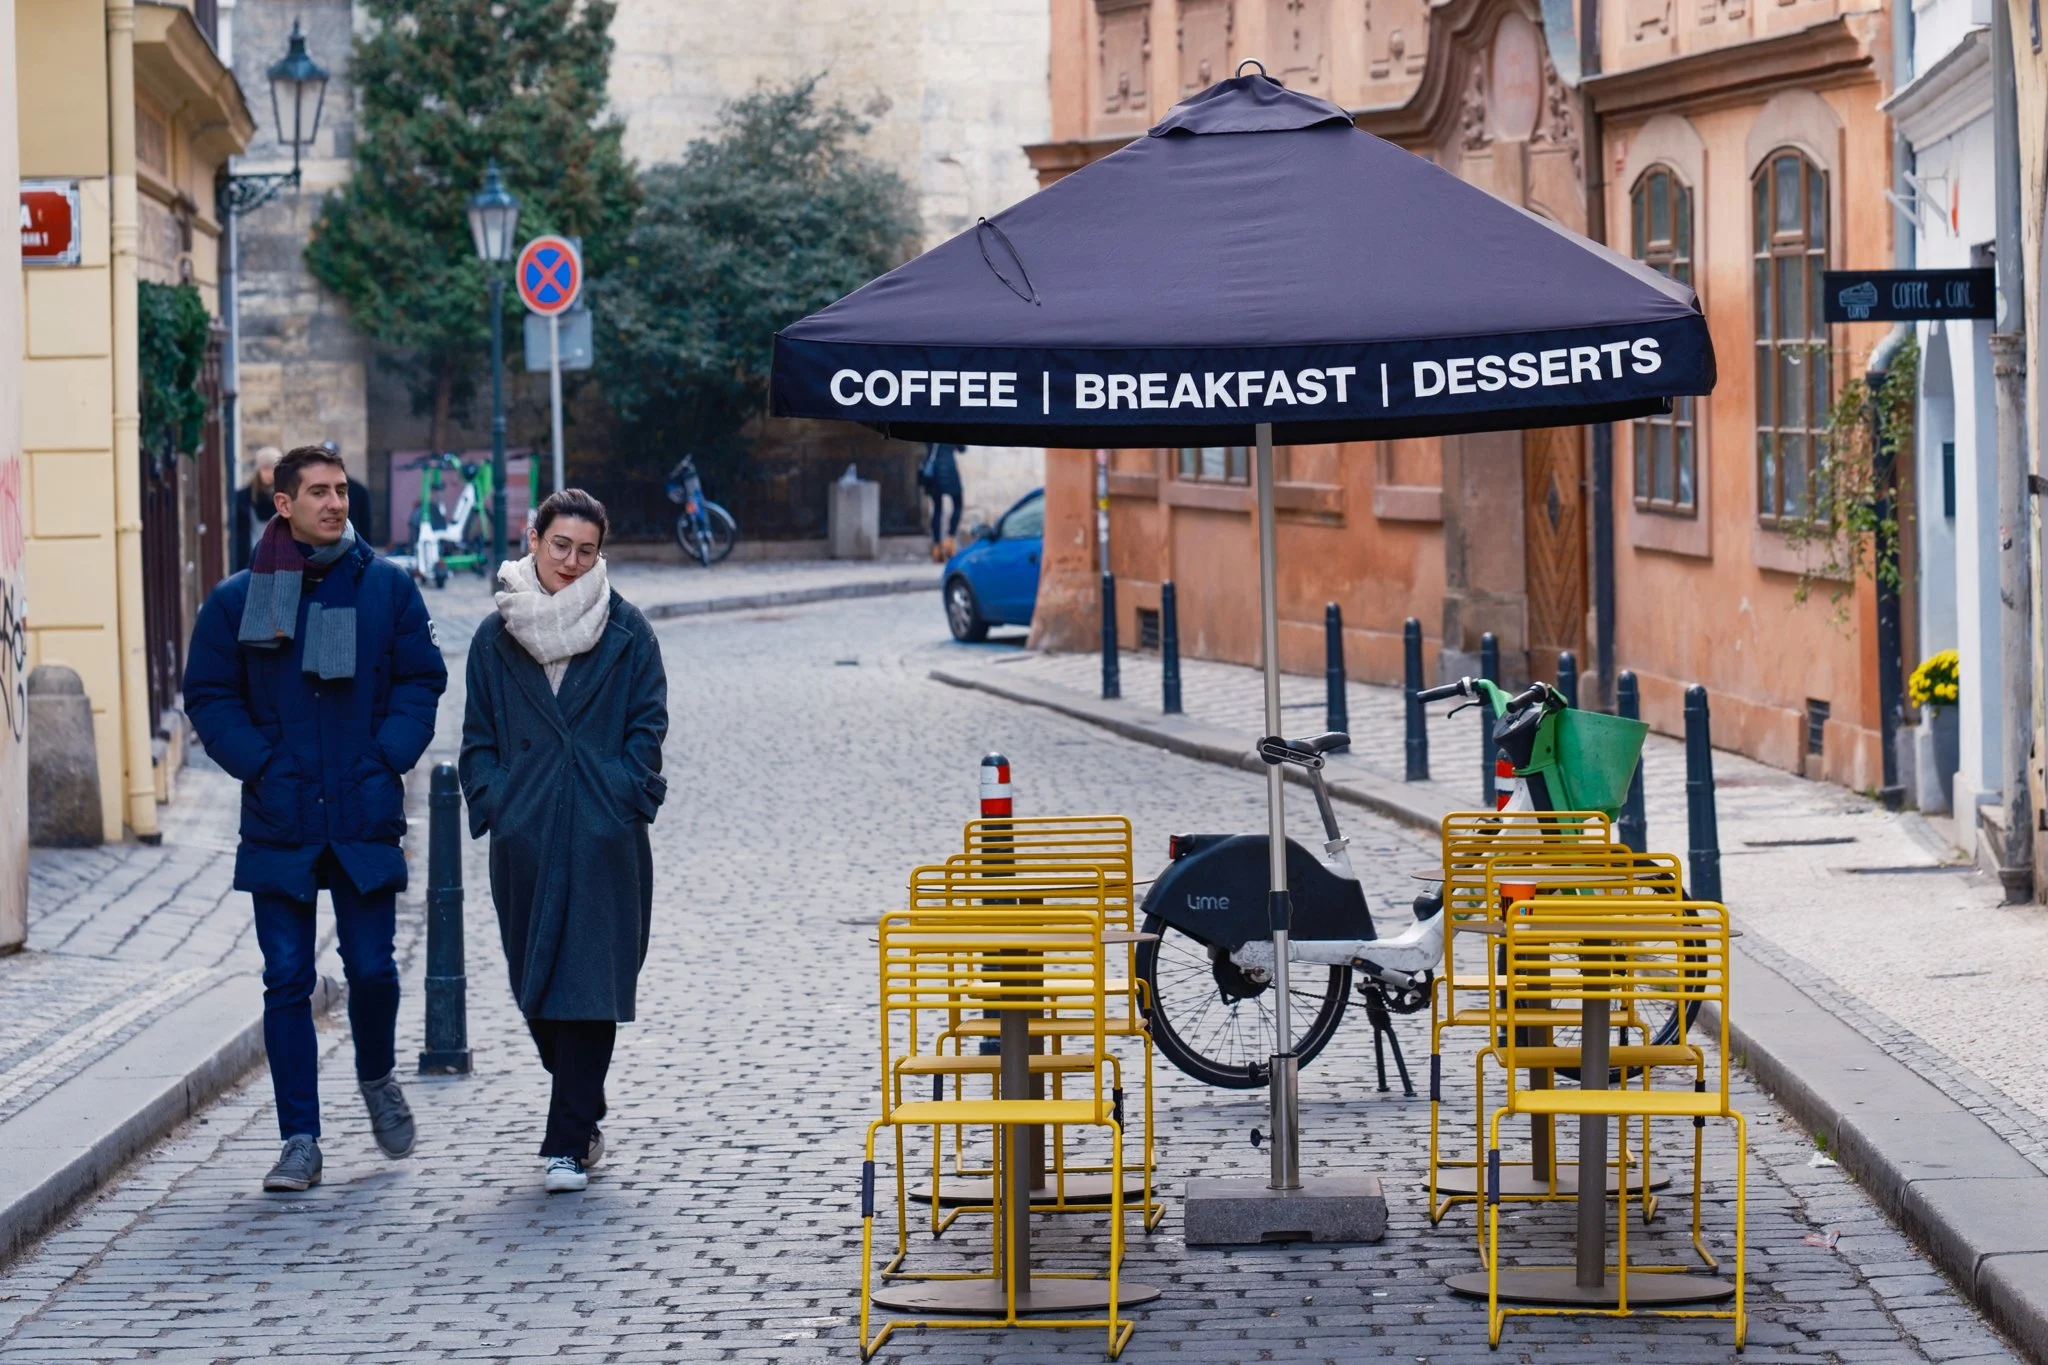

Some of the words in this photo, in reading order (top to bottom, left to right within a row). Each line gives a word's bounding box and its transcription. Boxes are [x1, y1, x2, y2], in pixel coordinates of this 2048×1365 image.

[830, 368, 1018, 408] COFFEE
[1075, 365, 1356, 410] BREAKFAST
[1412, 337, 1662, 398] DESSERTS
[1187, 893, 1230, 910] Lime
